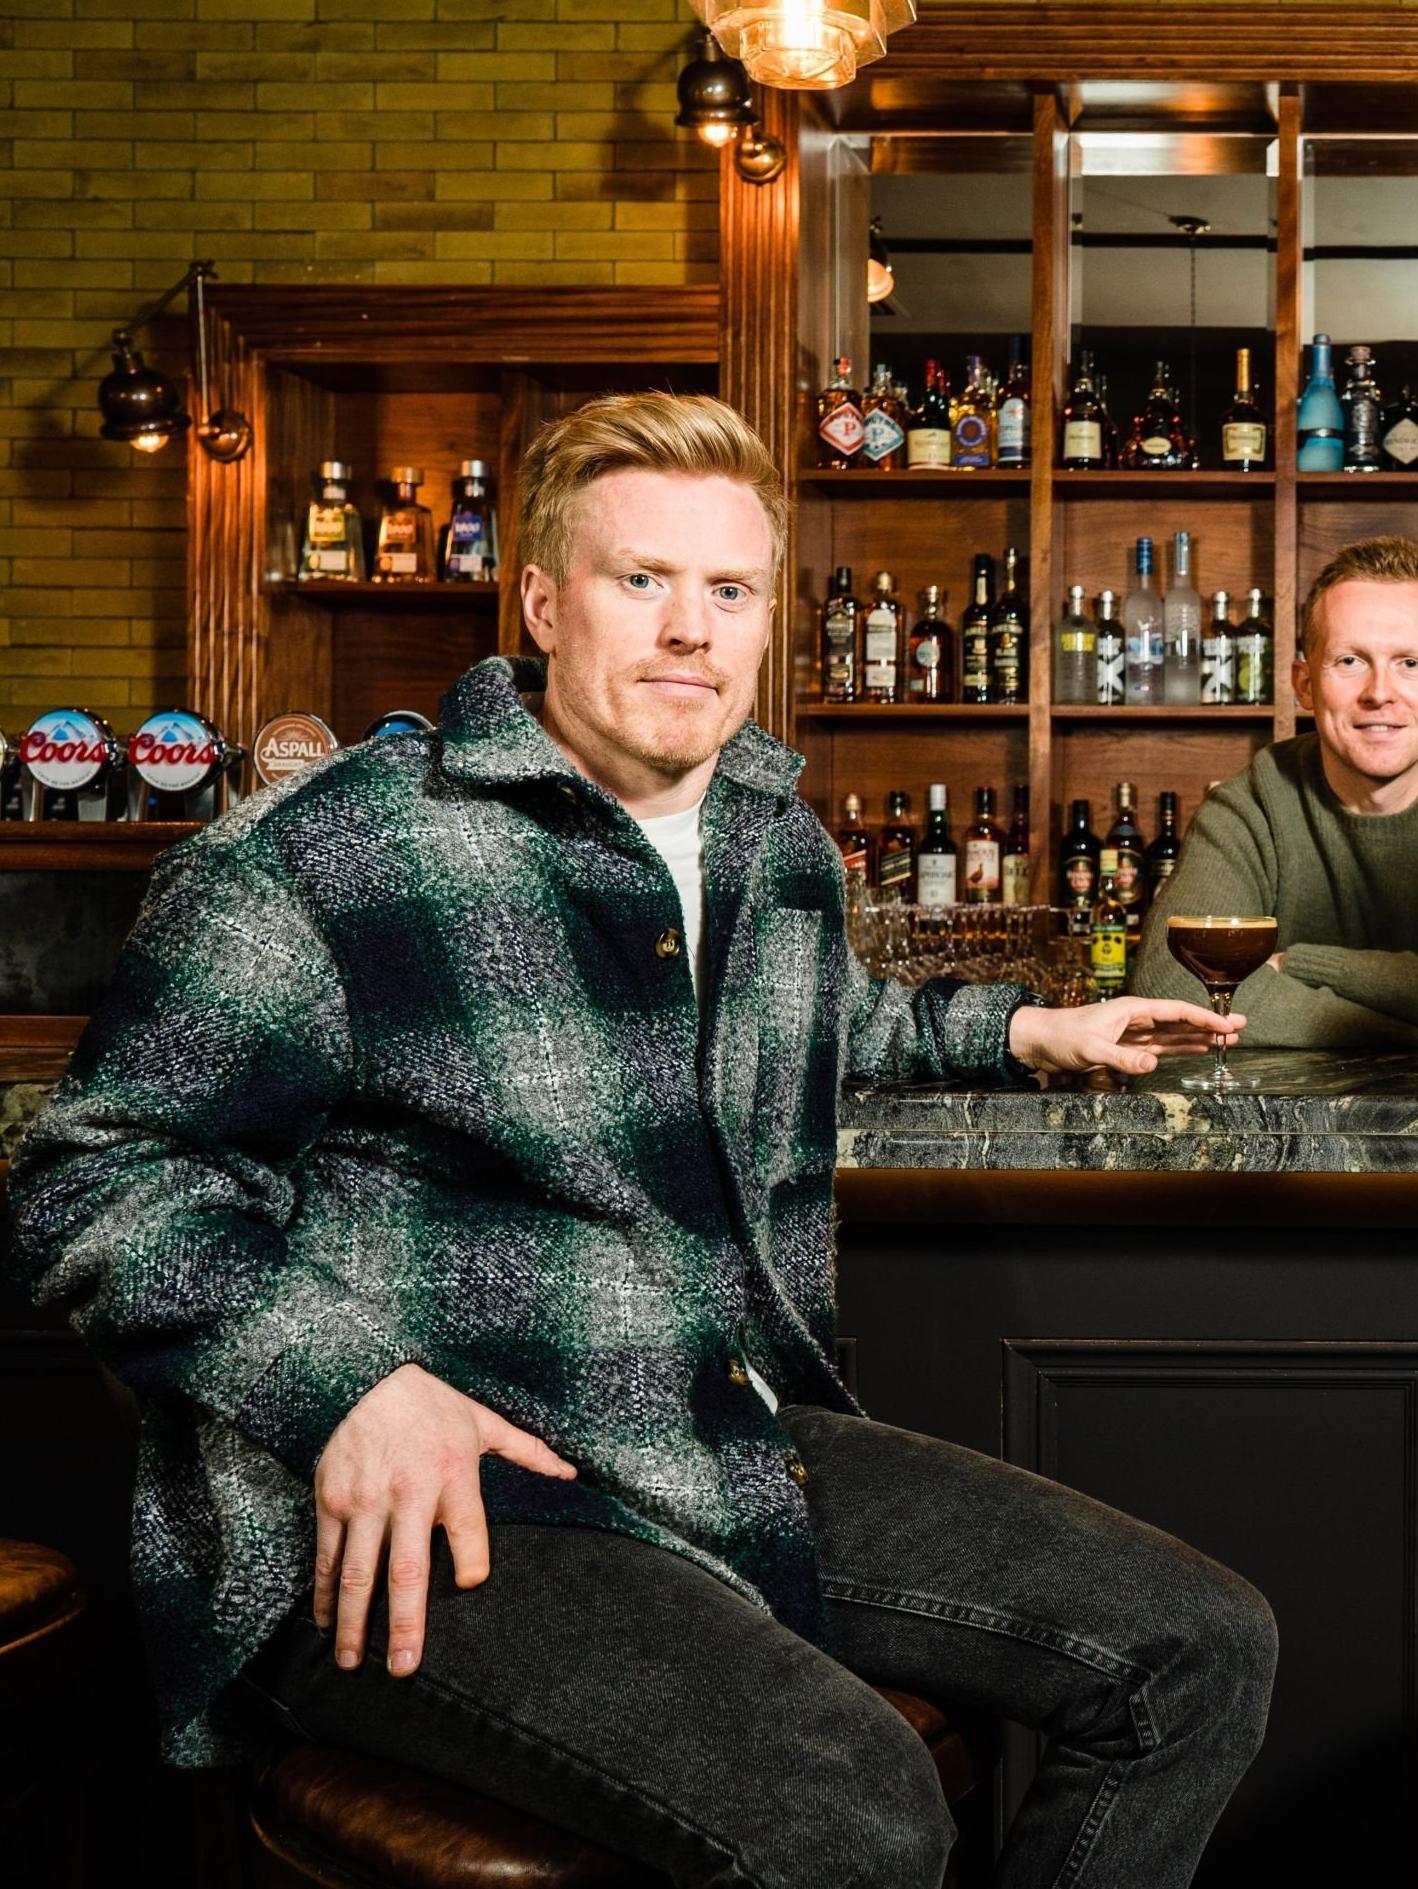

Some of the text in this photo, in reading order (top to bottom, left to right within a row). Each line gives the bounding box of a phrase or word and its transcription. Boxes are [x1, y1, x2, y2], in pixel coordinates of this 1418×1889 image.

[19, 731, 107, 764] Coors
[128, 733, 215, 765] Coors
[260, 737, 324, 760] ASPALL
